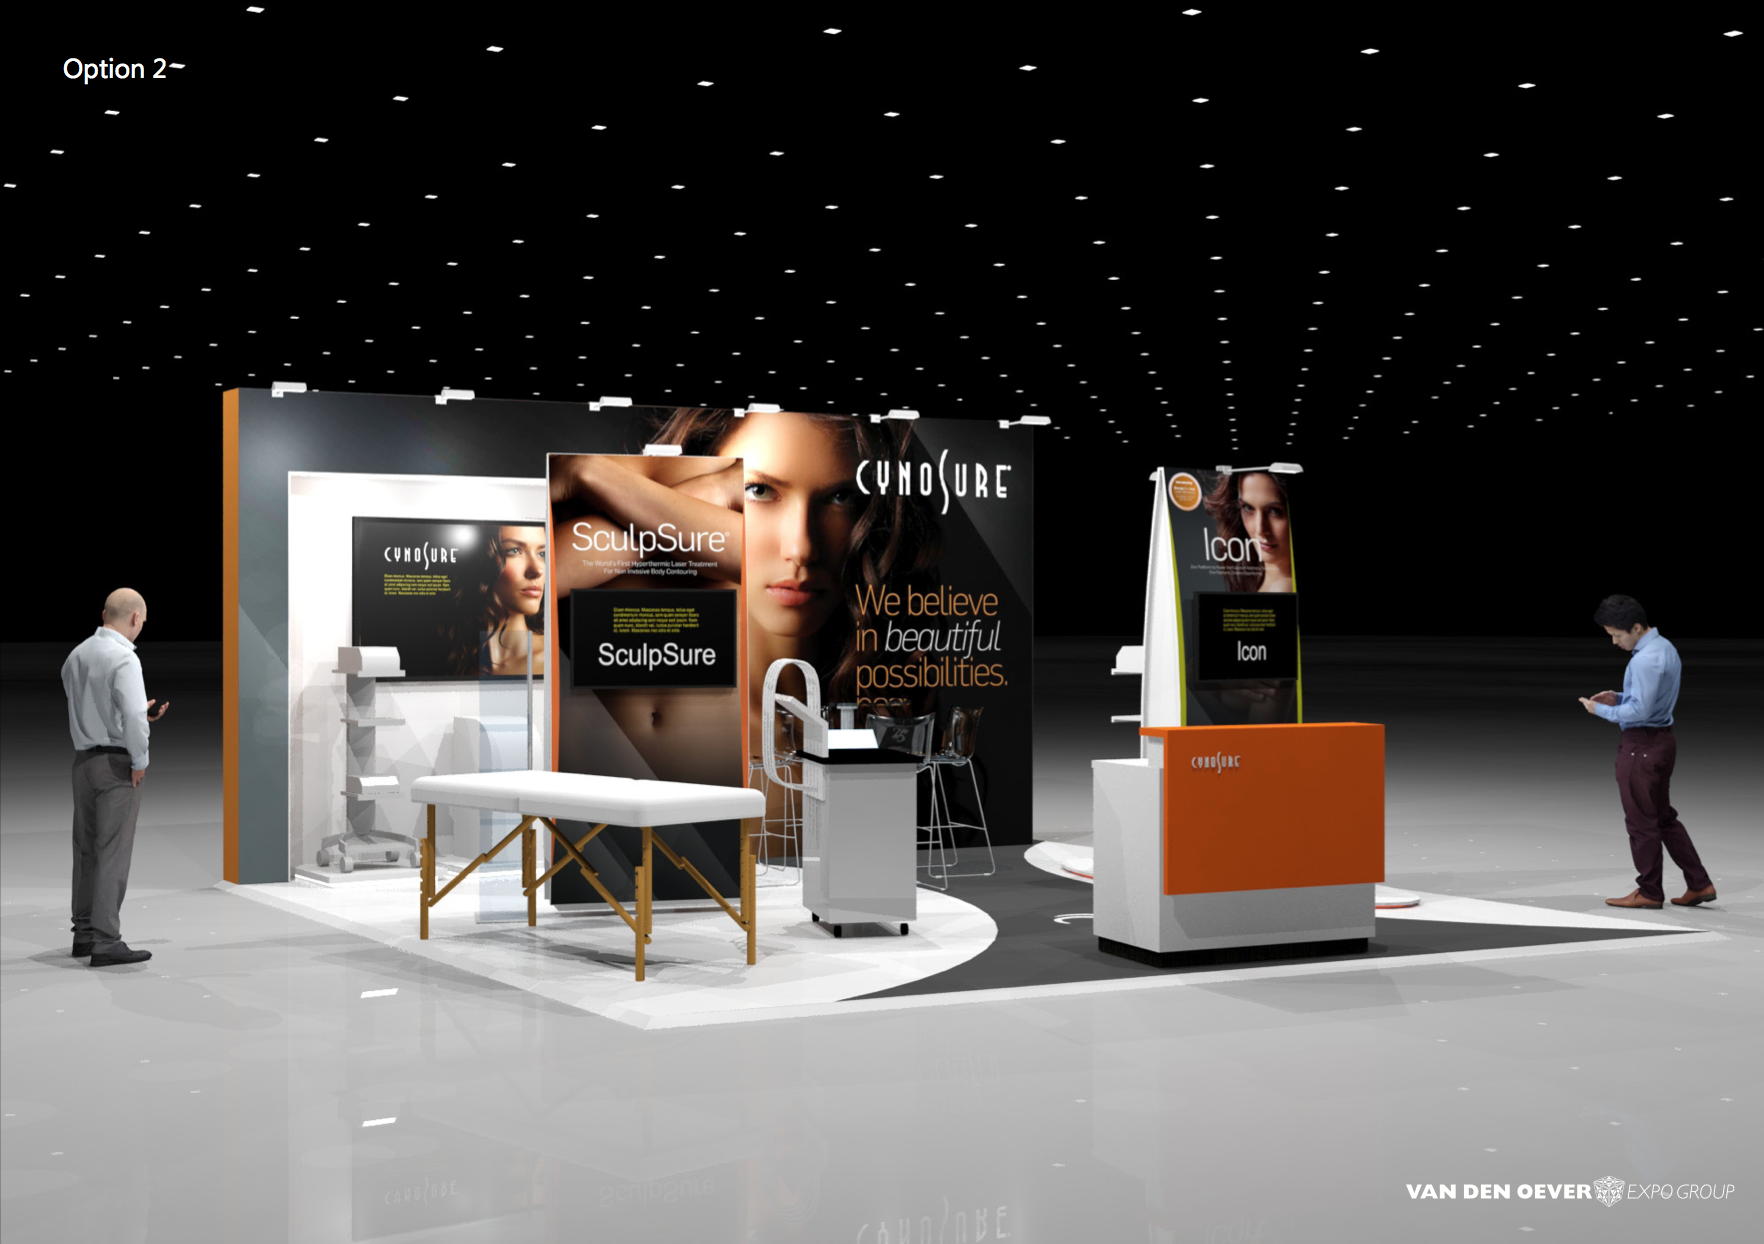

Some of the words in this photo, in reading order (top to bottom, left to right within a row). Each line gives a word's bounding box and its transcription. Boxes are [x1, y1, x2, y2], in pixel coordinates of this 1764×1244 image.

[856, 449, 1011, 515] CYNOSURE
[384, 541, 460, 571] CYNOSURE
[1203, 526, 1263, 563] Icon
[582, 559, 594, 567] The
[594, 559, 617, 568] World's
[617, 560, 631, 568] First
[631, 560, 671, 569] Hyperthermic
[671, 560, 688, 568] Laser
[688, 560, 719, 568] Treatment
[650, 568, 666, 577] Body
[666, 568, 698, 577] Contouring
[855, 584, 901, 617] We
[907, 584, 999, 617] believe
[855, 620, 878, 652] in
[884, 618, 1002, 660] beautiful
[1237, 639, 1267, 661] Icon
[598, 642, 717, 673] SculpSure
[855, 656, 1009, 696] possibilities.
[1191, 751, 1242, 774] CYNOSURE
